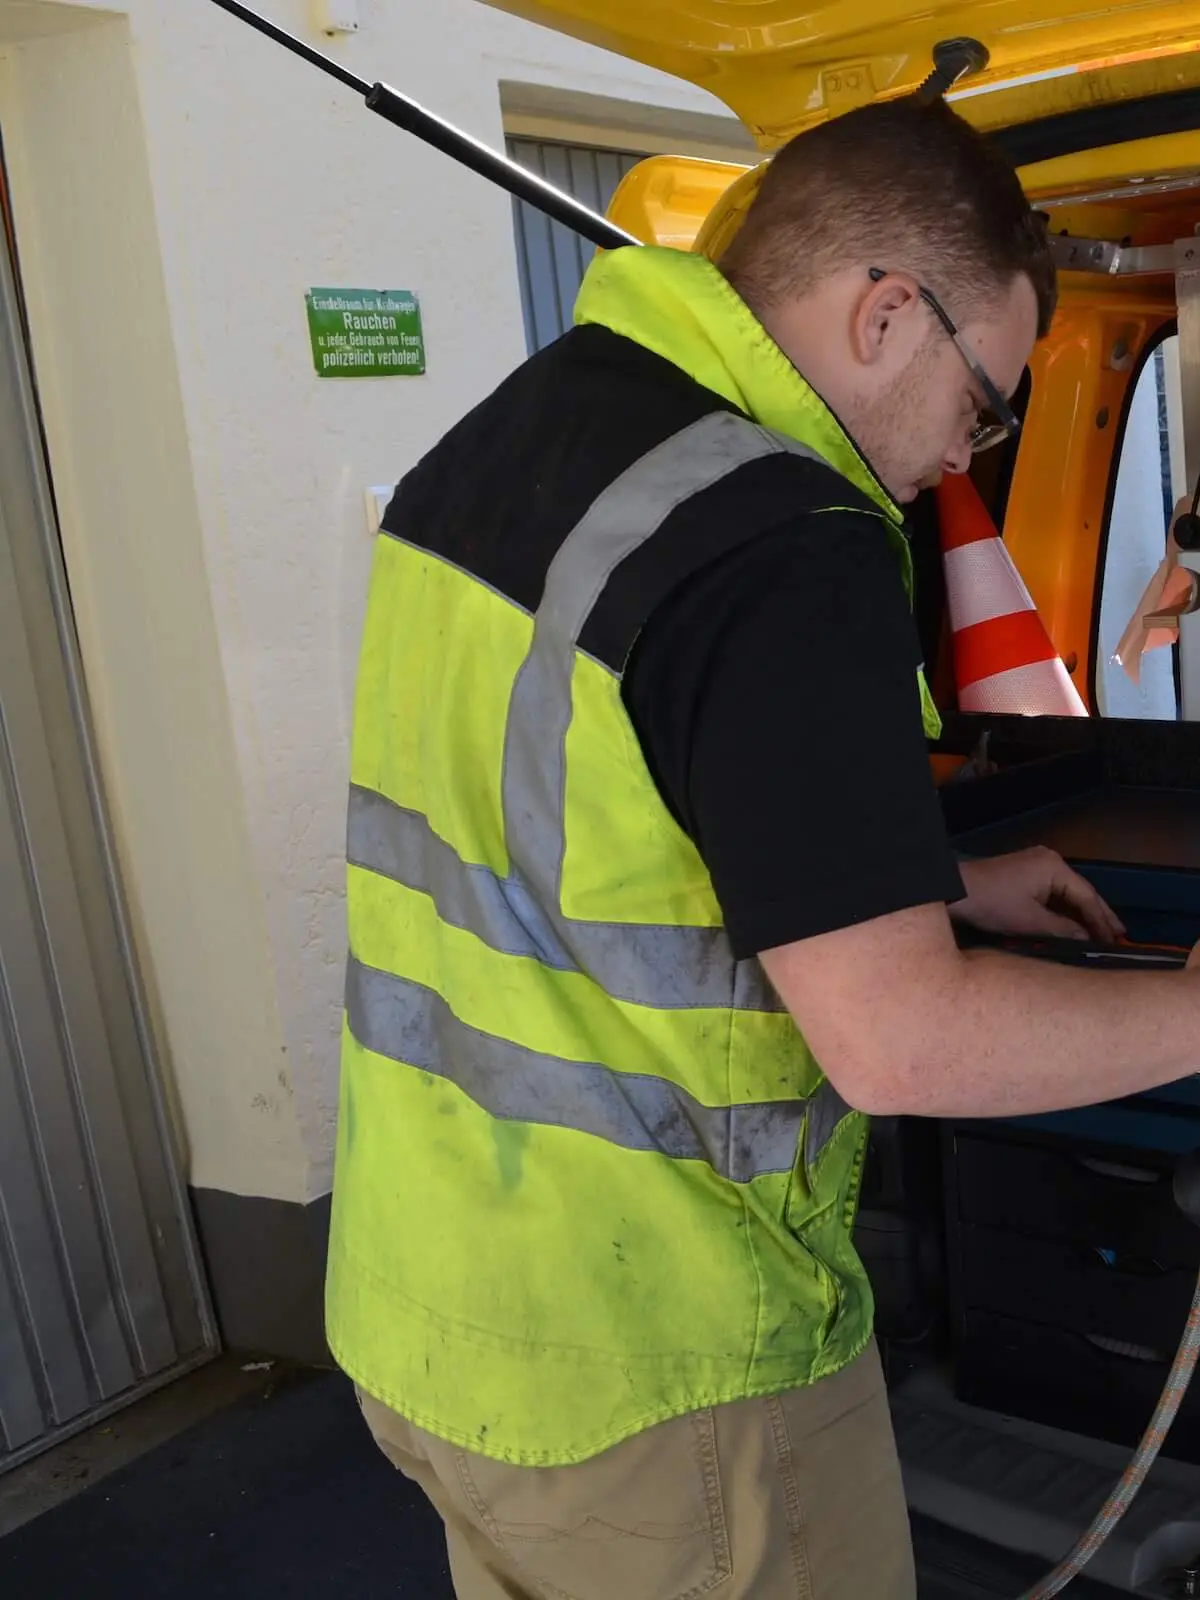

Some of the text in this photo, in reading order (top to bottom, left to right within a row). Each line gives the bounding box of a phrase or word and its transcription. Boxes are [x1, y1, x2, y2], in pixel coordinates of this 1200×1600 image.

[343, 311, 397, 330] Rauchen
[326, 332, 347, 348] jeder
[349, 331, 385, 347] Gebrauch
[387, 335, 399, 347] von
[322, 350, 375, 368] polizeilich
